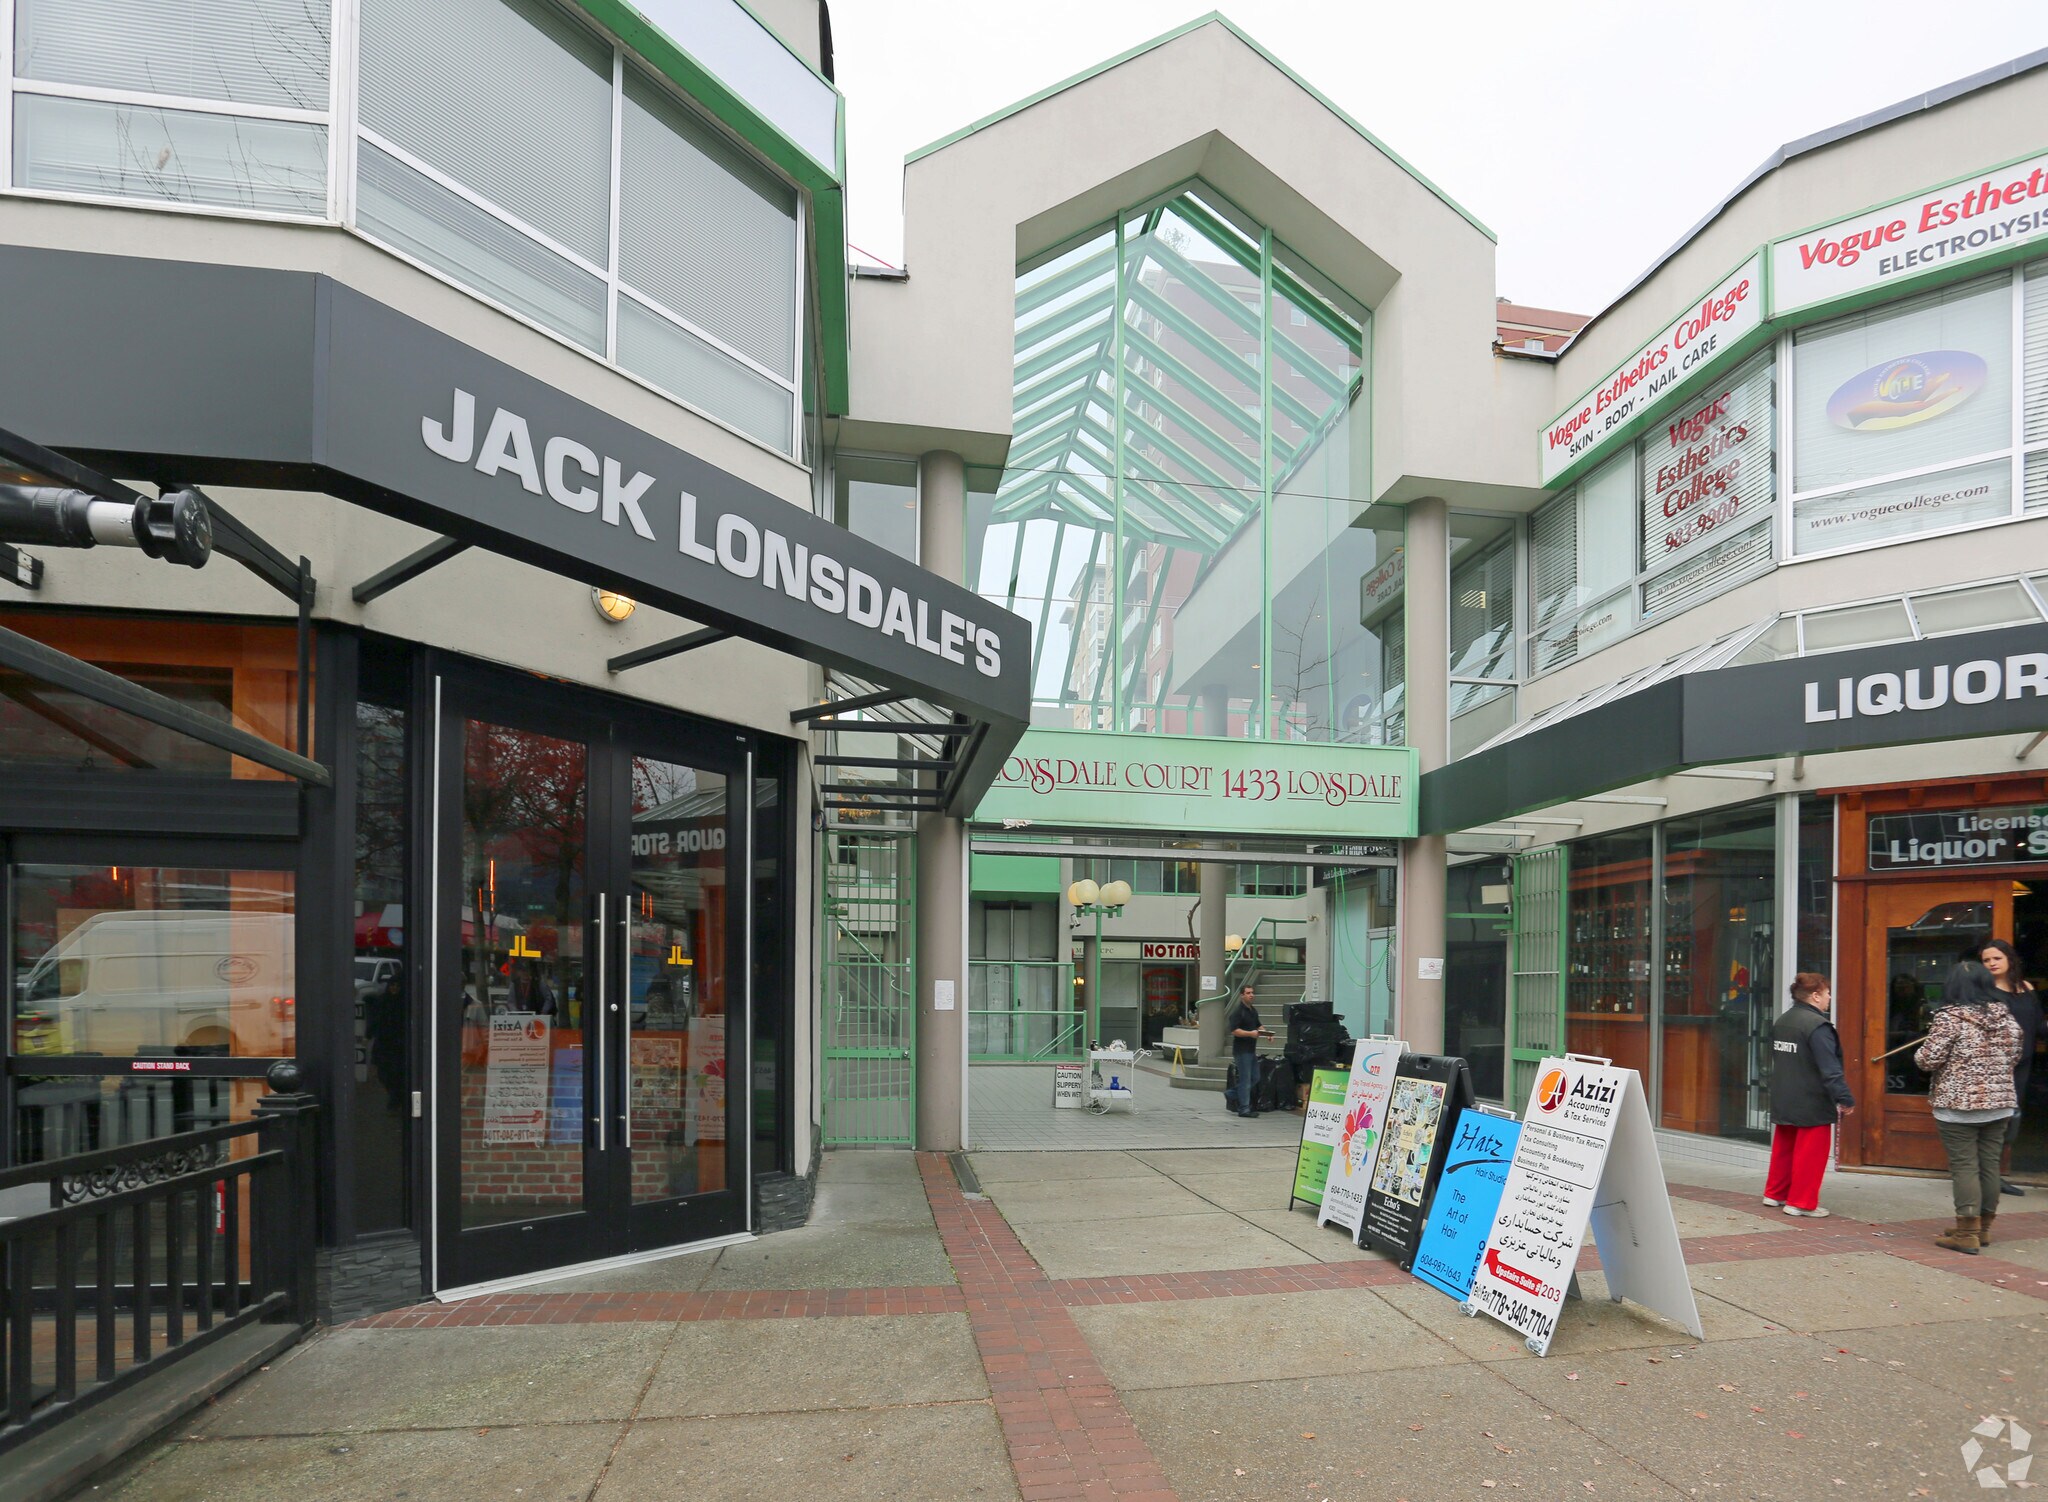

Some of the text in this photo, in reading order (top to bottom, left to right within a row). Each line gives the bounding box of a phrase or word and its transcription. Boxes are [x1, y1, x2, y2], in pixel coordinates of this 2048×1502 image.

[1799, 219, 1907, 270] Vogue
[1548, 278, 1749, 450] Vogue Esthetics College
[1569, 431, 1594, 458] SKIN
[1605, 400, 1637, 431] BODY
[1648, 368, 1678, 398] NAIL
[1682, 334, 1718, 371] CARE
[1668, 391, 1732, 448] Vogue
[1655, 420, 1749, 495] Esthetics
[1663, 458, 1741, 518] College
[1810, 485, 1989, 529] www.voguecollege.com
[421, 387, 1002, 679] JACK LONSDALE'S
[1664, 495, 1740, 553] 983-9900
[1805, 652, 2048, 723] LIQUOR
[994, 757, 1402, 807] ONSDALE COURT 1433 LONSDALE
[1891, 837, 2006, 865] Liquor
[175, 1062, 190, 1070] BACK
[1571, 1074, 1618, 1103] Azizi
[1563, 1110, 1606, 1127] & Tax Services
[1567, 1099, 1610, 1117] Accounting
[1456, 1123, 1504, 1157] Hatz
[1524, 1134, 1558, 1151] Tax Consulting
[1527, 1124, 1547, 1135] Personal
[1553, 1131, 1575, 1142] Business
[1576, 1137, 1585, 1145] Tax
[1586, 1140, 1604, 1150] Return
[1475, 1166, 1487, 1178] Hair
[1517, 1156, 1550, 1171] Business Plan
[1520, 1146, 1546, 1159] Accounting
[1552, 1154, 1584, 1171] Bookkeeping
[1331, 1185, 1363, 1203] 604-770-1433
[1384, 1196, 1400, 1211] Echo's
[1452, 1189, 1466, 1204] The
[1446, 1207, 1469, 1224] Art of
[1441, 1225, 1458, 1240] Hair
[1420, 1253, 1462, 1282] 604-987-1643
[1496, 1265, 1520, 1283] Upstairs
[1520, 1275, 1535, 1290] Suite
